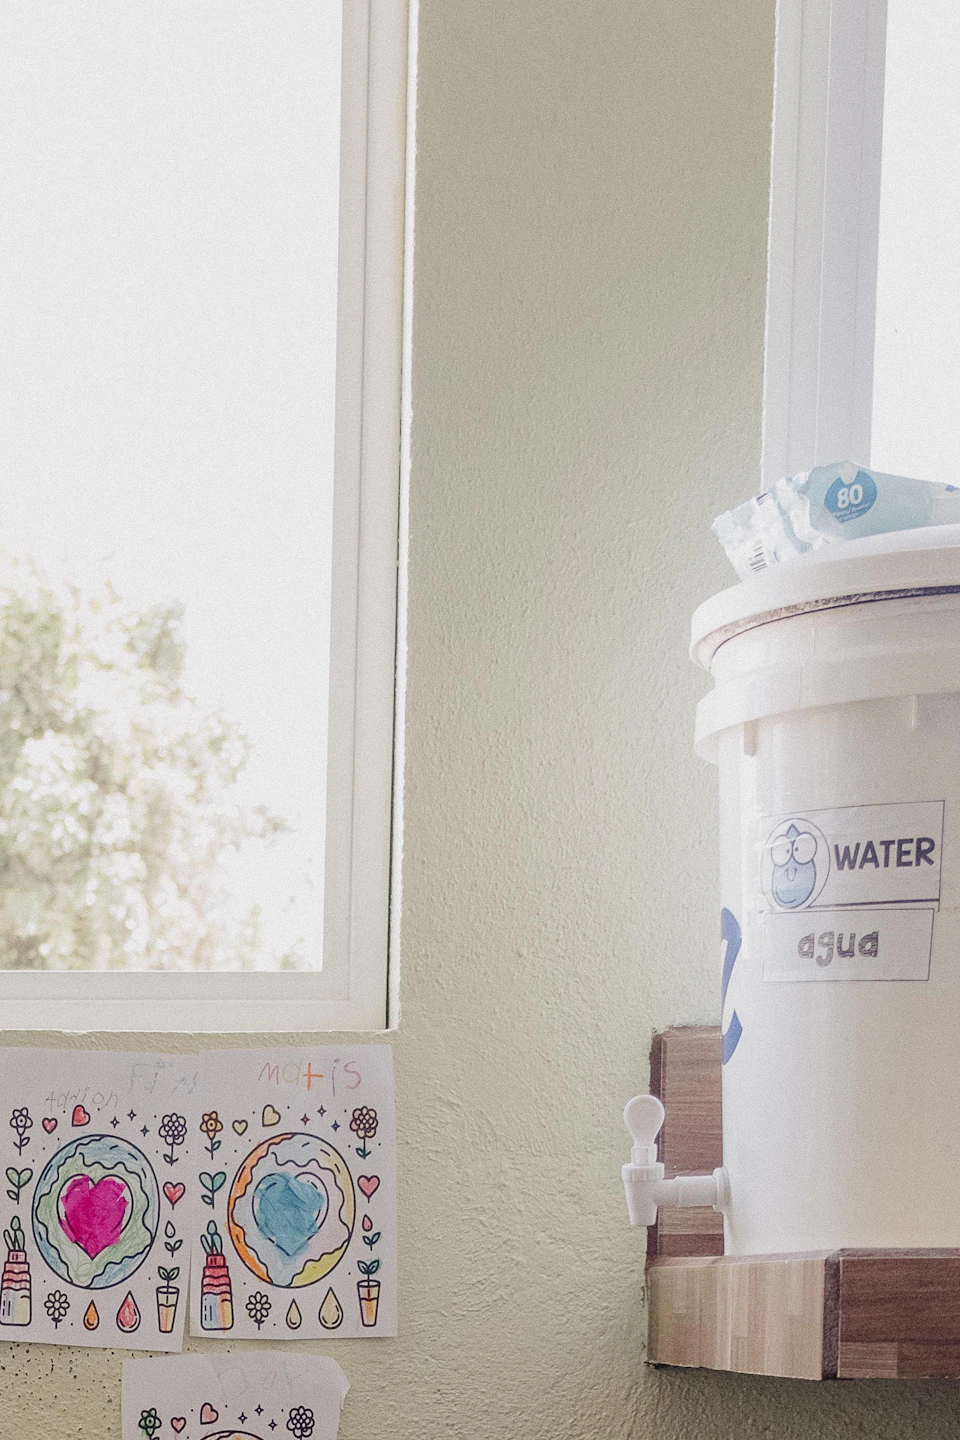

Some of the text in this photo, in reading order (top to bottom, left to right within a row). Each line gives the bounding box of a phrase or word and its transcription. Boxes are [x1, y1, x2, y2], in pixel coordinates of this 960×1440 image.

[837, 483, 863, 509] 80
[833, 836, 936, 871] WATER
[797, 930, 880, 967] agua
